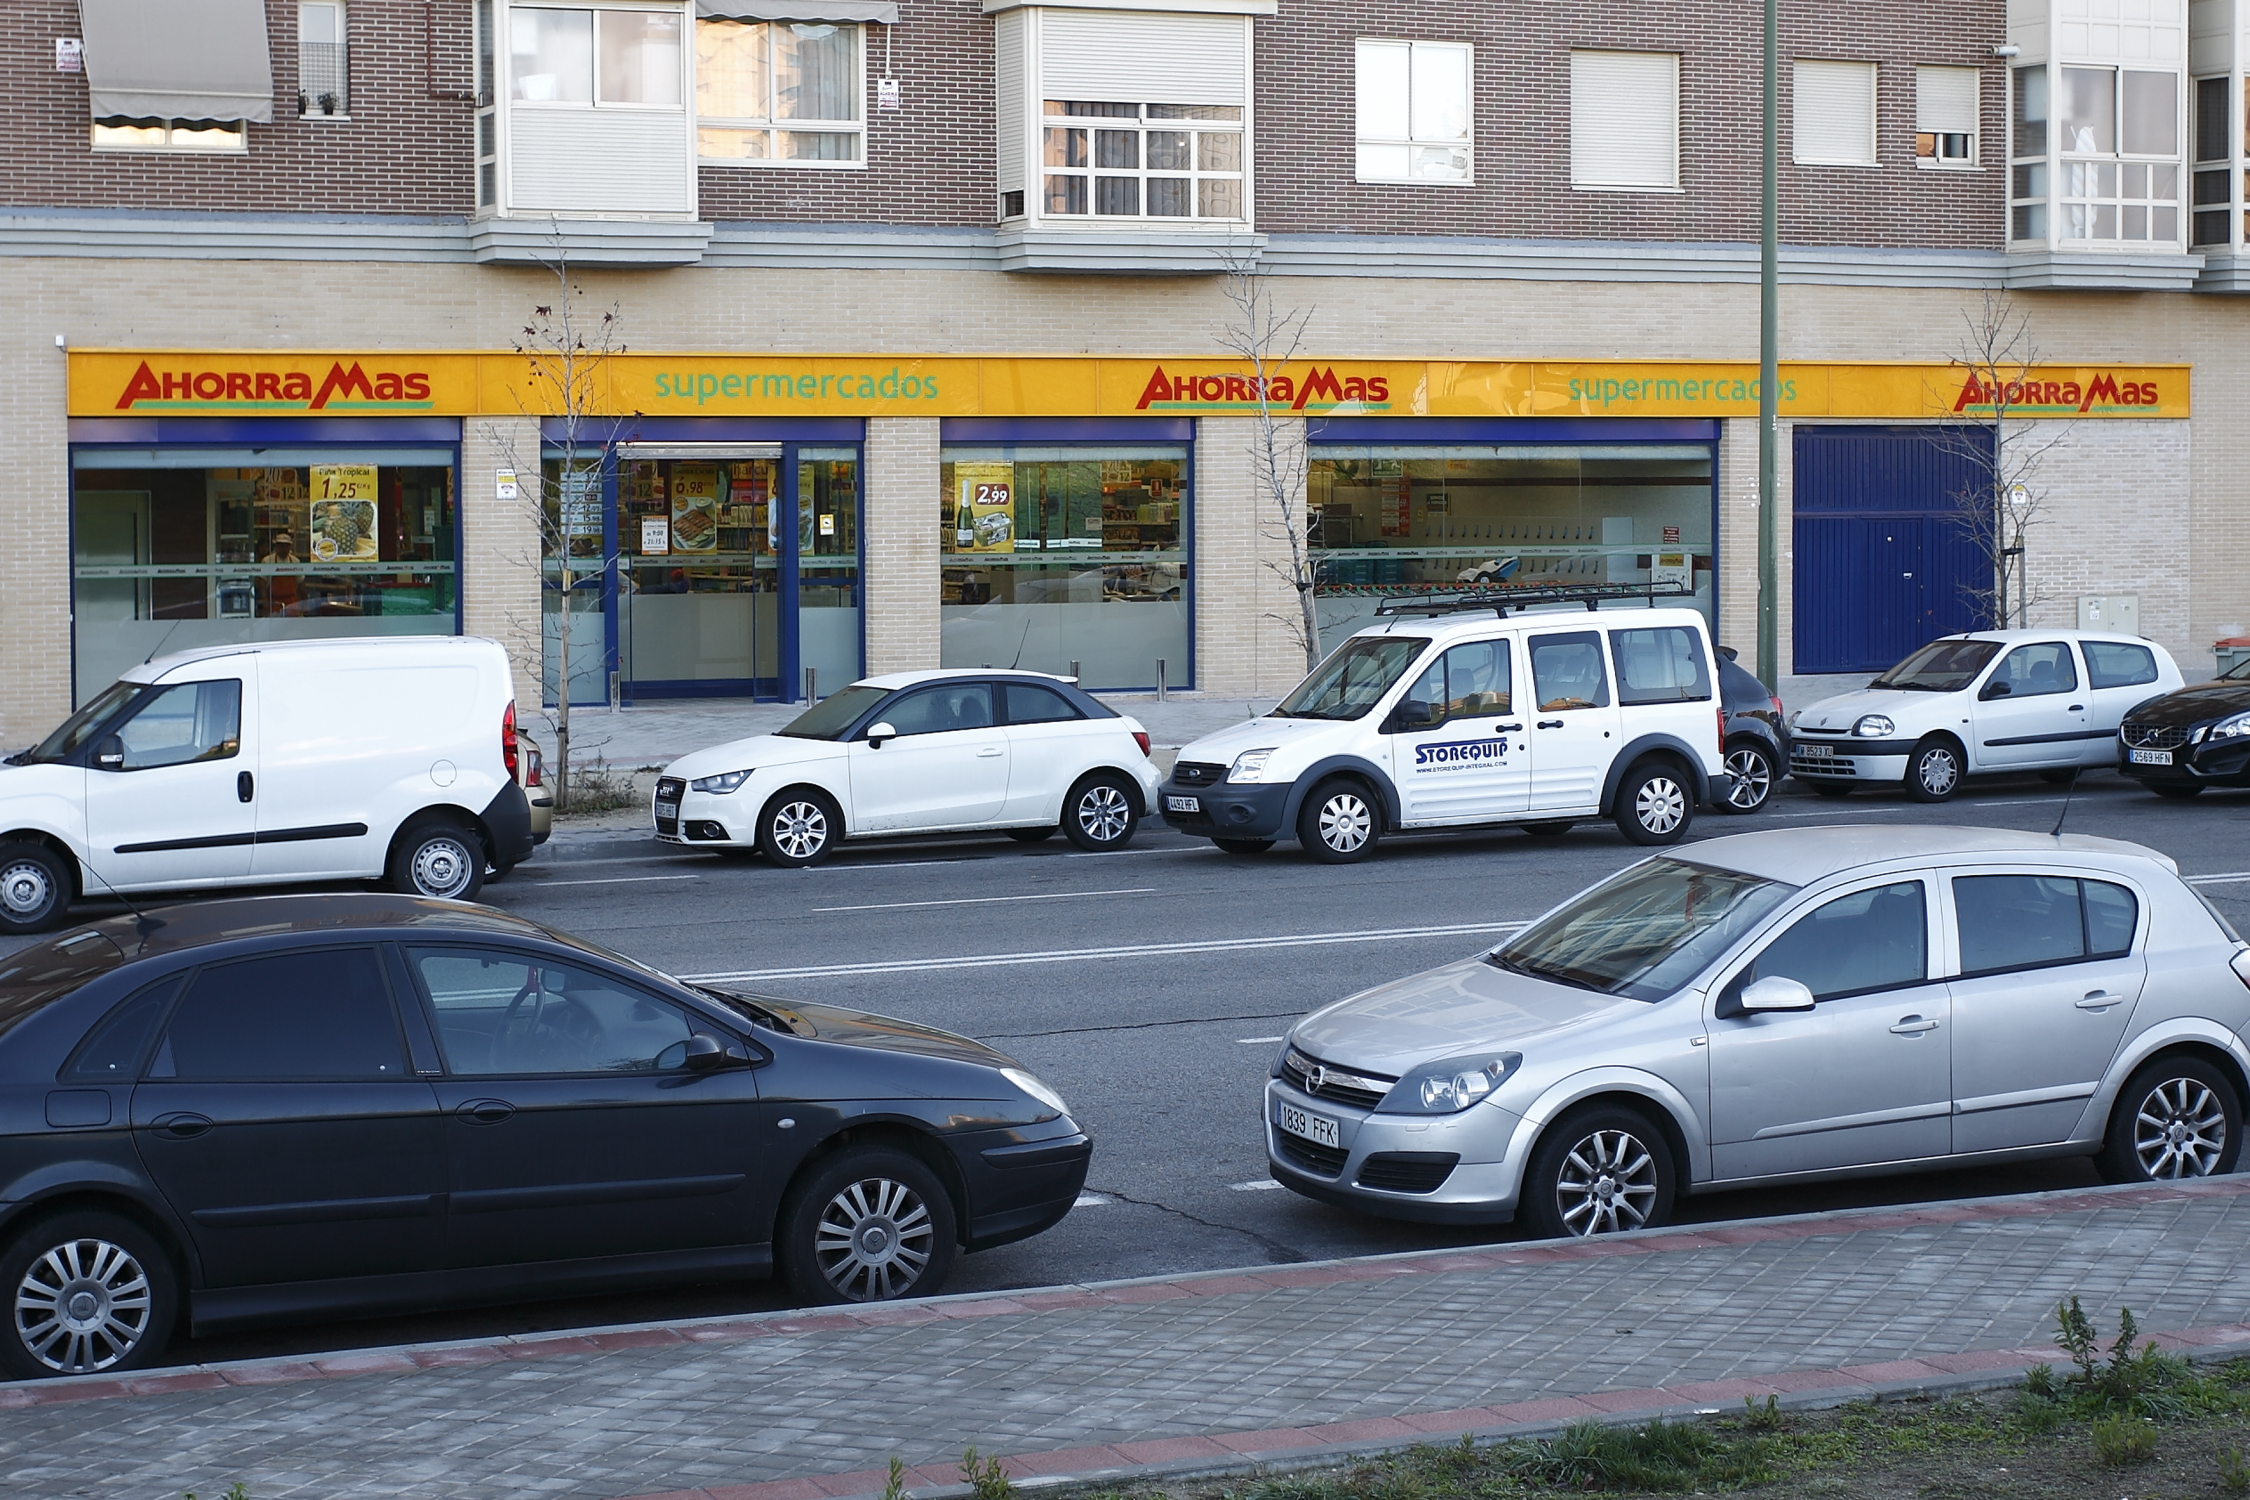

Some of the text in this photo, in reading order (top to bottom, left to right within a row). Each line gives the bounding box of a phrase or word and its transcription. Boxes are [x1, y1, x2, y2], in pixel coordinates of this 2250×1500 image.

[655, 366, 939, 406] supermercados
[338, 467, 370, 477] Tropical
[321, 477, 357, 499] 1,25
[977, 485, 1008, 504] 2,99
[1415, 737, 1509, 764] STOREQUIP
[1806, 745, 1822, 757] 8523
[2134, 751, 2171, 764] 2569 HFN
[1169, 797, 1185, 811] 4492
[1283, 1106, 1336, 1144] 1839 FFK
